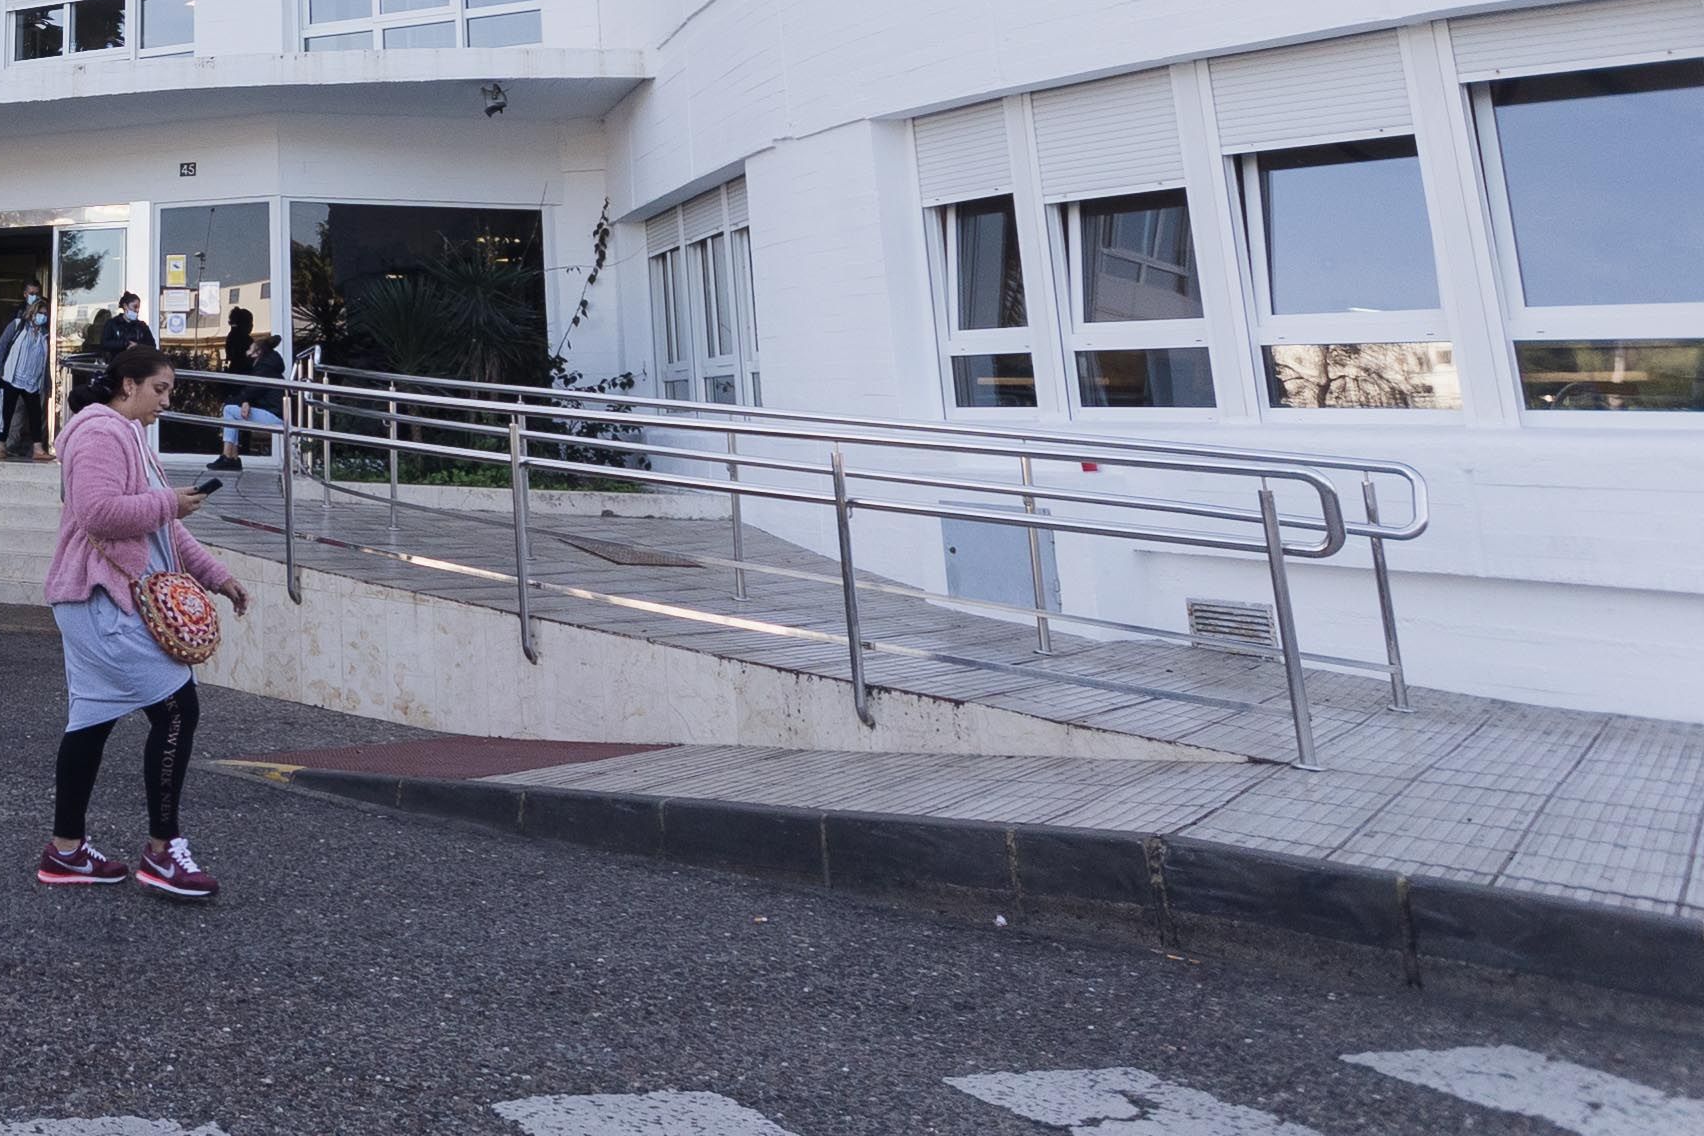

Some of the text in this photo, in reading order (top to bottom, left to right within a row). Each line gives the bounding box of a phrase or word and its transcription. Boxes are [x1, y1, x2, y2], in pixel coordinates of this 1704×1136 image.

[181, 163, 195, 176] 45
[168, 713, 181, 746] NEW
[160, 748, 176, 785] YORK
